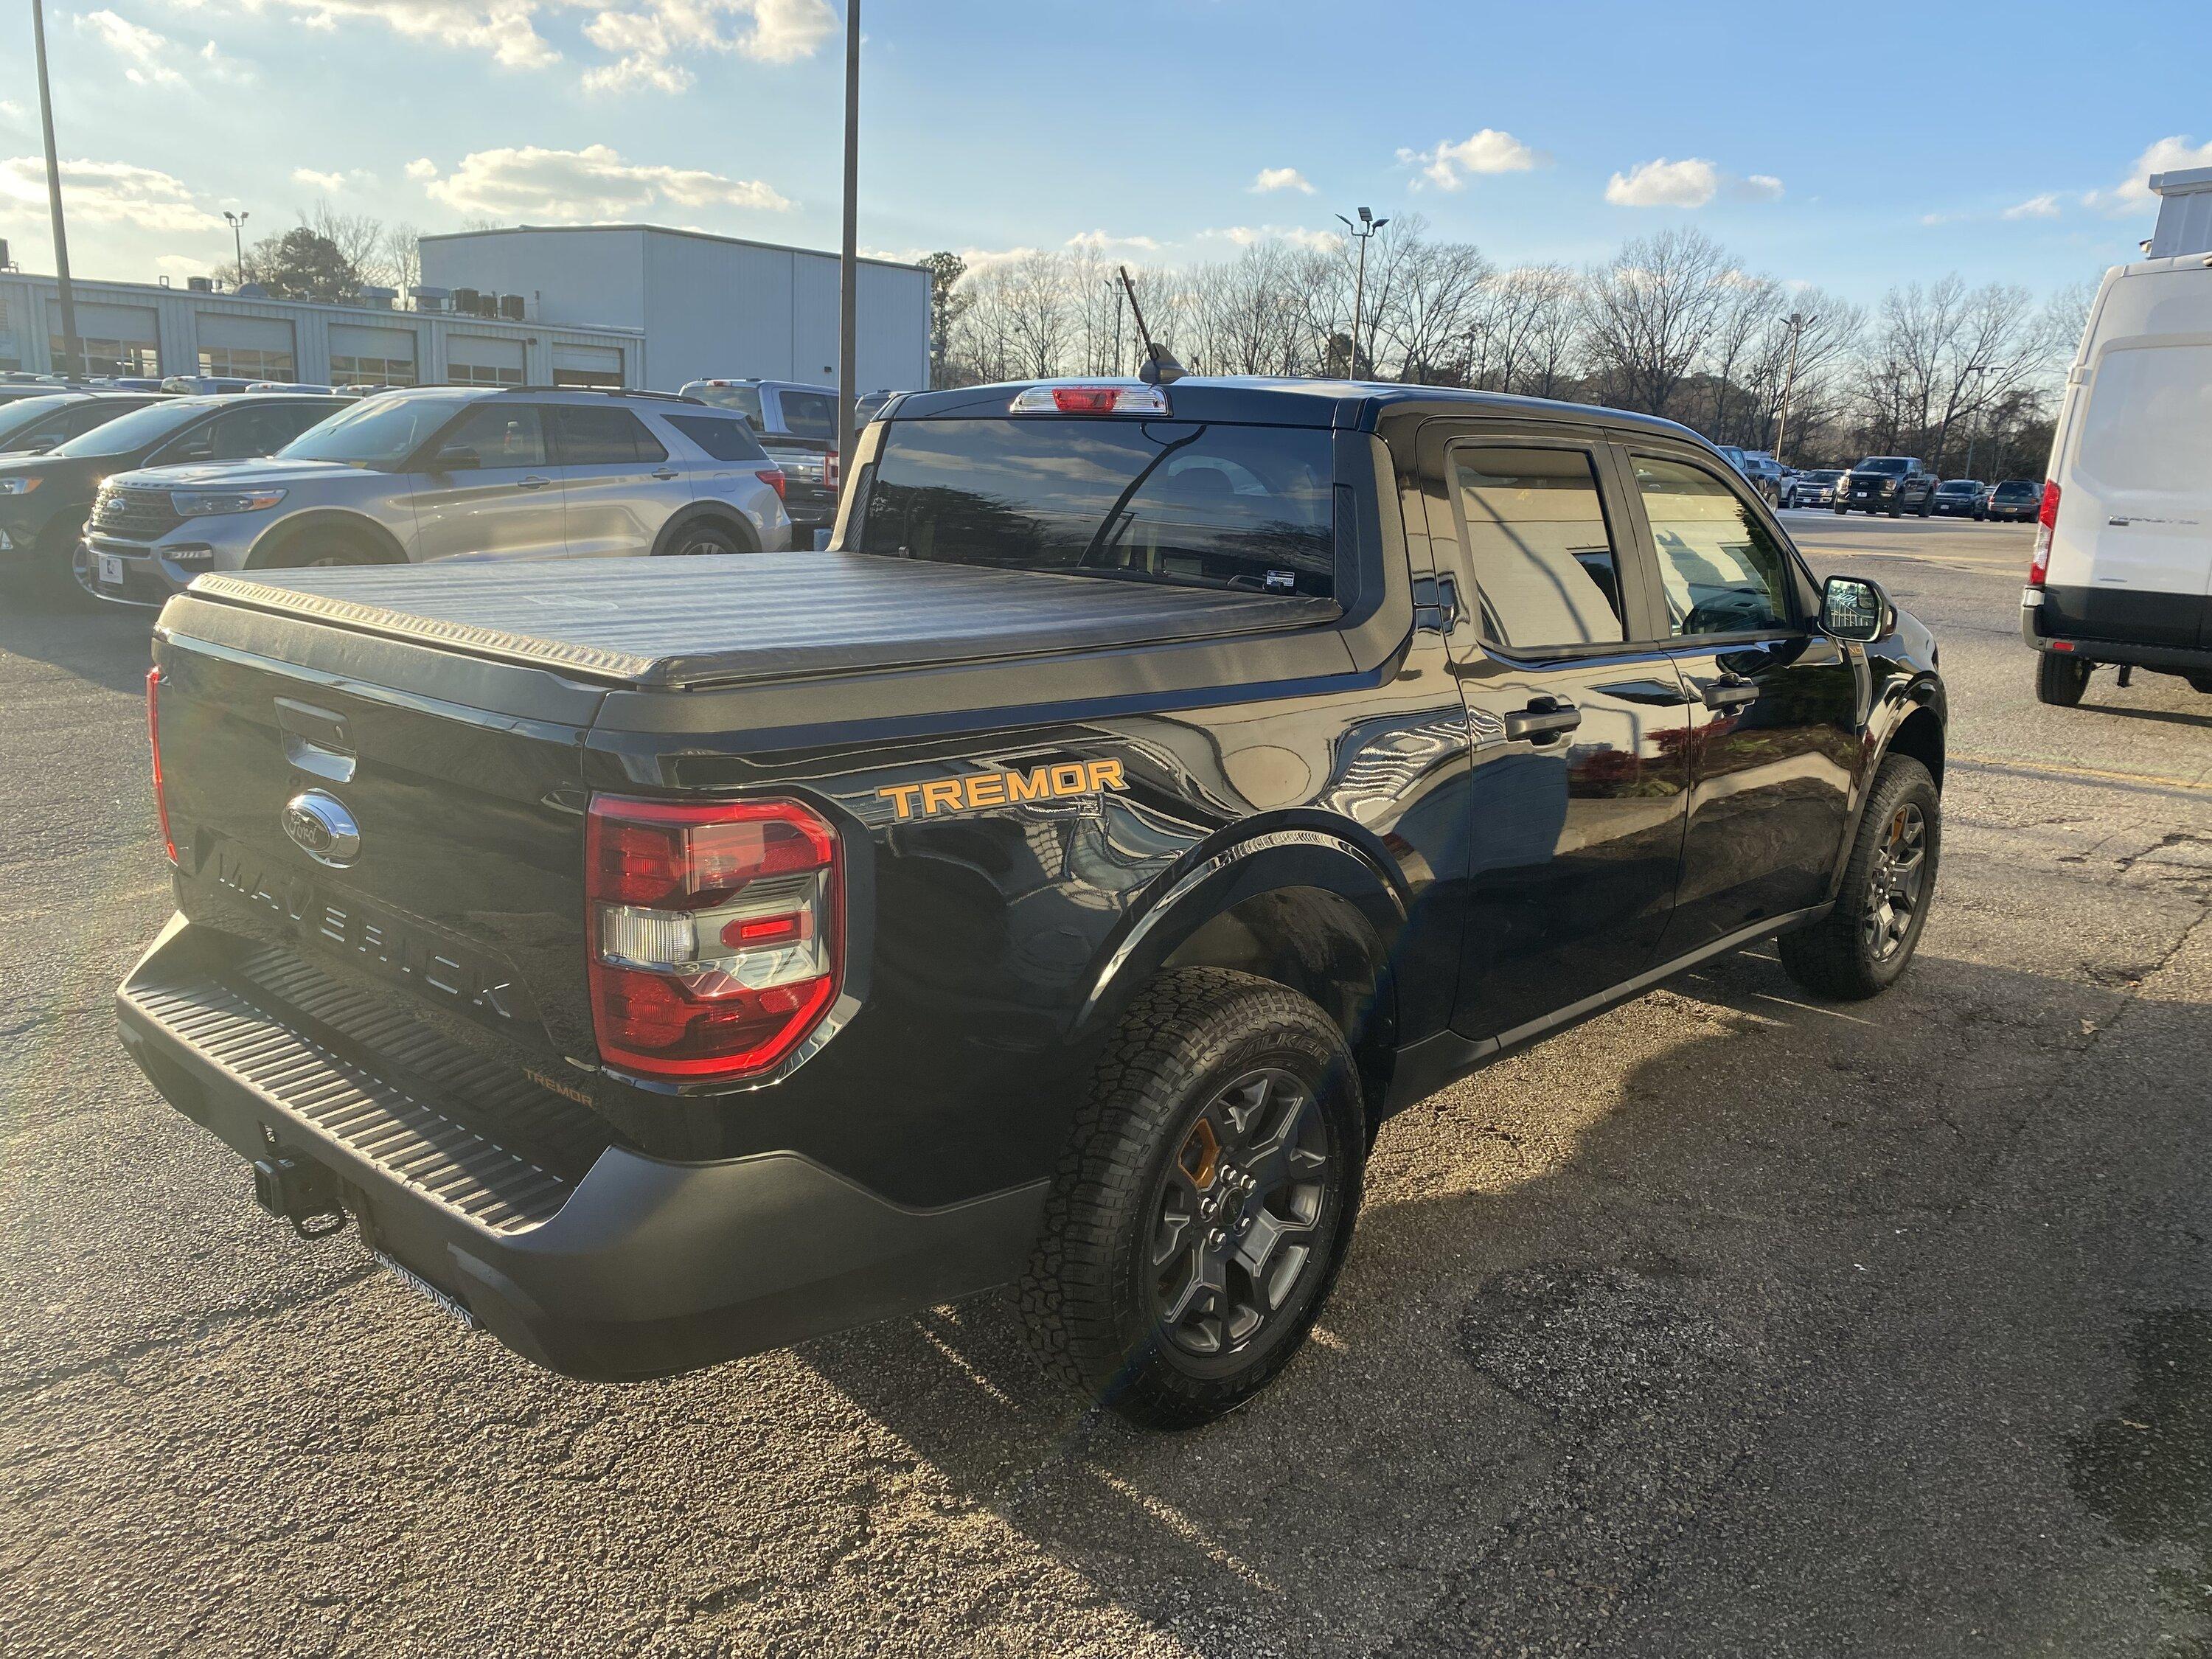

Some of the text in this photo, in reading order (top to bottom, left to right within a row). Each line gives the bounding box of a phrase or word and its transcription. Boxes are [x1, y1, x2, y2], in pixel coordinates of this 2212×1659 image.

[879, 759, 1126, 818] TREMOR
[288, 814, 317, 844] Ford
[524, 1067, 596, 1110] TREMOR
[411, 1276, 434, 1301] FORD
